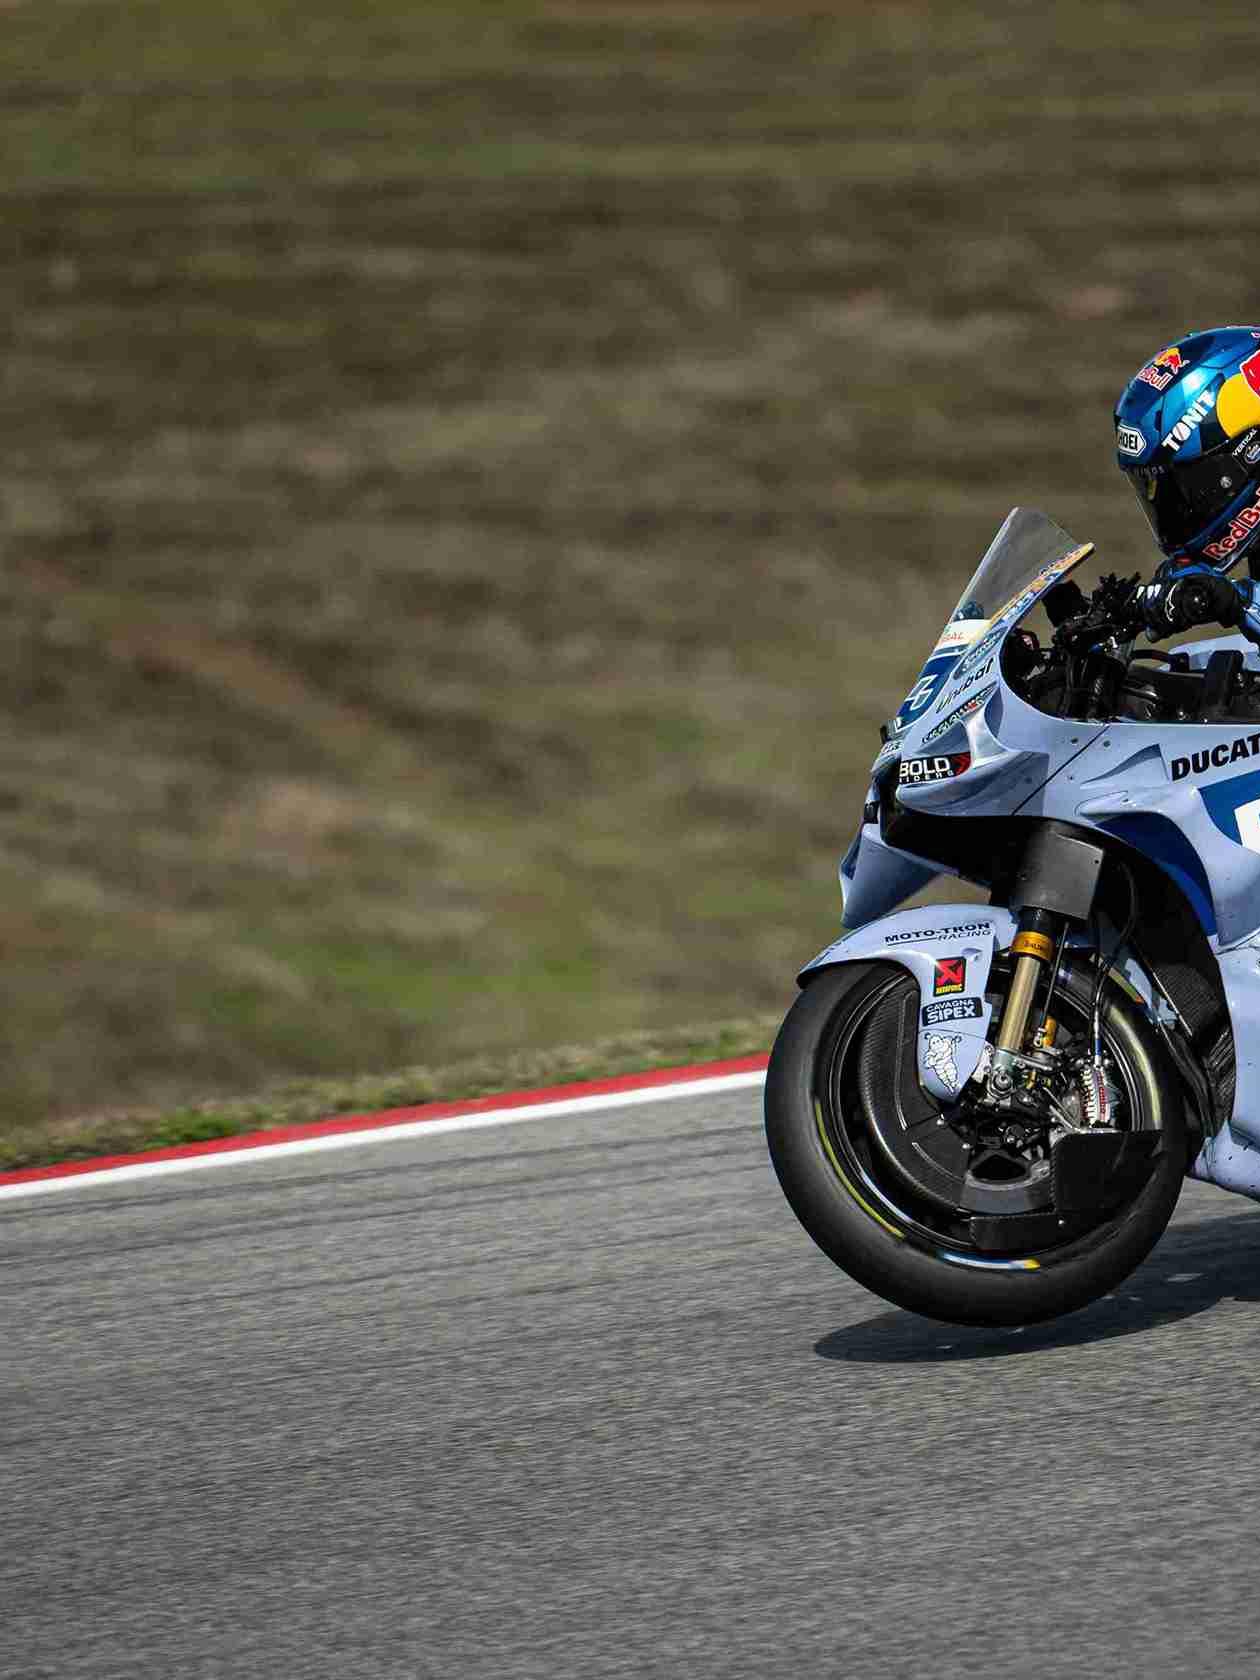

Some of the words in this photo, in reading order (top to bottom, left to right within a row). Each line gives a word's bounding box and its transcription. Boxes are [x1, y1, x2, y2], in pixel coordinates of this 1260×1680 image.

[1119, 433, 1139, 451] HOEI
[1202, 521, 1250, 560] Red
[900, 757, 951, 777] BOLD
[885, 921, 991, 944] MOTO-TRON
[937, 929, 993, 942] RACING
[926, 999, 975, 1013] CAVAGNA
[927, 1005, 976, 1024] SIPEX
